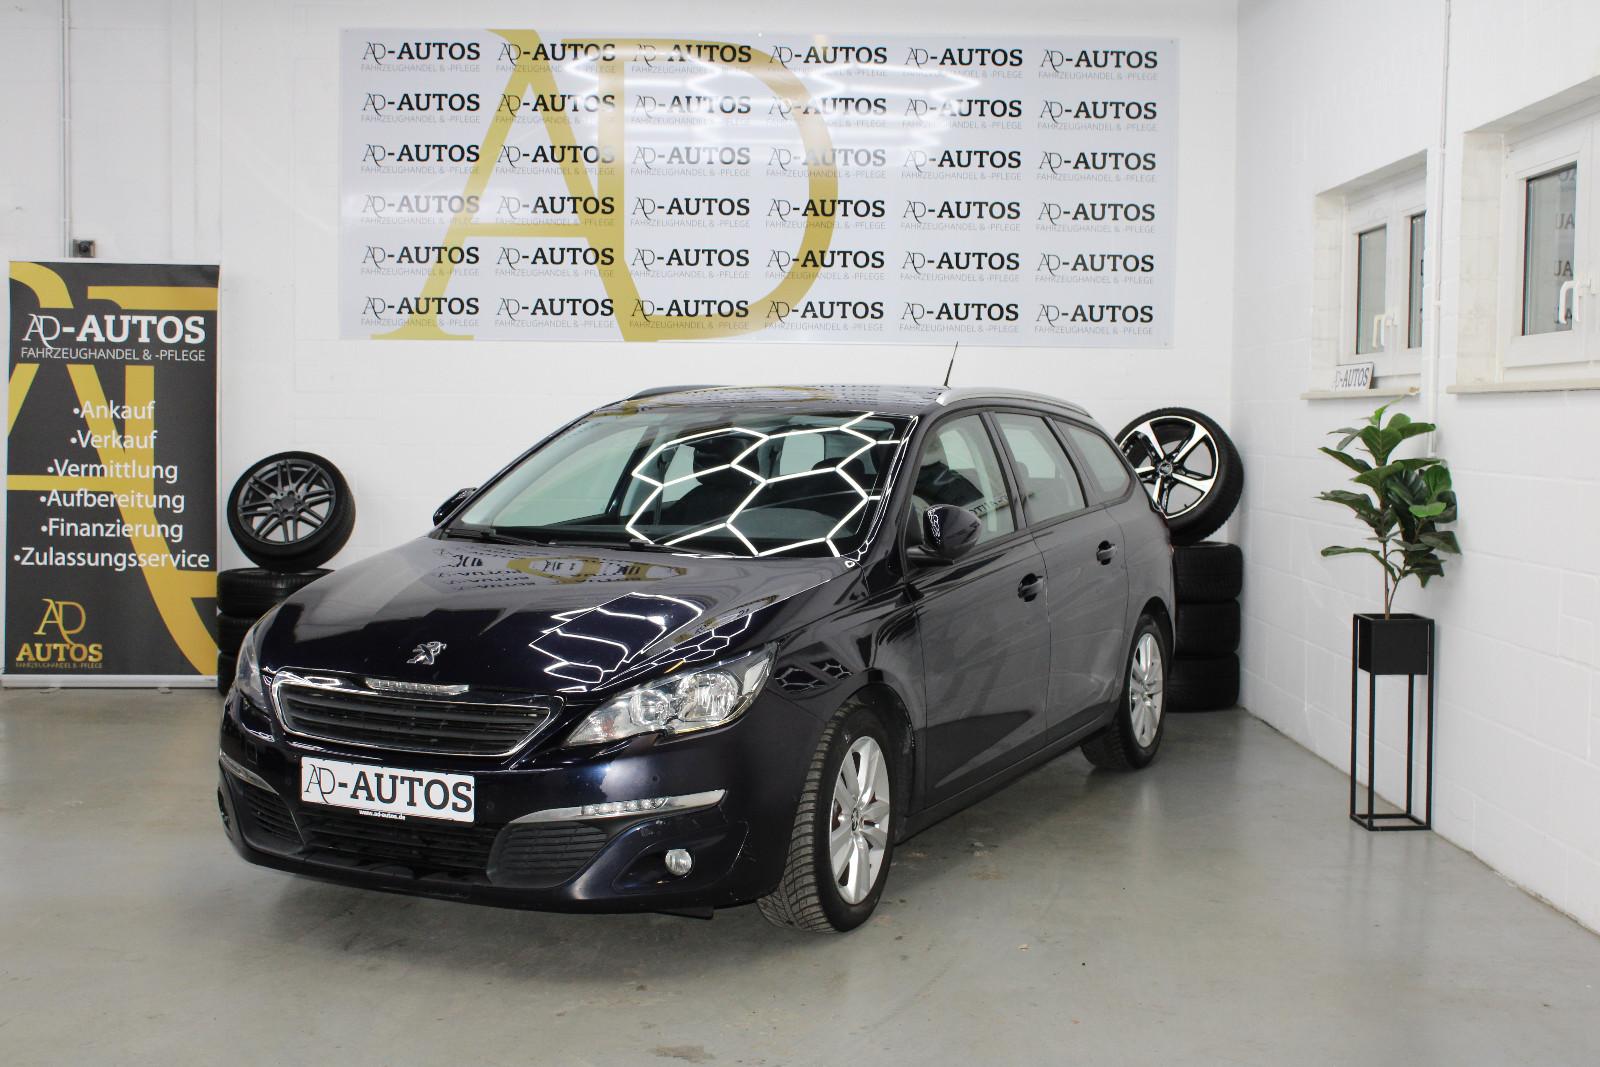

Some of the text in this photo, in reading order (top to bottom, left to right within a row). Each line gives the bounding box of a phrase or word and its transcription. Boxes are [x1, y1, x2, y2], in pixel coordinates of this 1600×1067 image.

[362, 42, 480, 66] AD-AUTOS
[498, 43, 616, 67] AD-AUTOS
[769, 46, 887, 70] AD-AUTOS
[904, 47, 1022, 72] AD-AUTOS
[1040, 48, 1158, 73] AD-AUTOS
[362, 93, 480, 117] AD-AUTOS
[1039, 99, 1157, 124] AD-AUTOS
[362, 144, 480, 168] AD-AUTOS
[498, 145, 615, 170] AD-AUTOS
[903, 149, 1021, 174] AD-AUTOS
[1038, 150, 1156, 175] AD-AUTOS
[362, 195, 479, 220] AD-AUTOS
[497, 196, 614, 221] AD-AUTOS
[632, 197, 750, 222] AD-AUTOS
[767, 199, 885, 224] AD-AUTOS
[903, 200, 1020, 225] AD-AUTOS
[1038, 201, 1155, 226] AD-AUTOS
[362, 245, 479, 271] AD-AUTOS
[497, 247, 614, 272] AD-AUTOS
[632, 248, 749, 273] AD-AUTOS
[767, 250, 884, 275] AD-AUTOS
[902, 251, 1019, 276] AD-AUTOS
[1037, 252, 1154, 277] AD-AUTOS
[362, 296, 479, 322] AD-AUTOS
[497, 298, 614, 324] AD-AUTOS
[632, 299, 748, 325] AD-AUTOS
[767, 301, 883, 326] AD-AUTOS
[901, 302, 1018, 327] AD-AUTOS
[1036, 303, 1153, 328] AD-AUTOS
[22, 313, 206, 349] AD-AUTOS
[21, 347, 139, 361] FAHRZEUGHANDEL
[142, 350, 152, 361] &
[15, 642, 104, 662] AUTOS
[304, 763, 473, 813] AD-AUTOS
